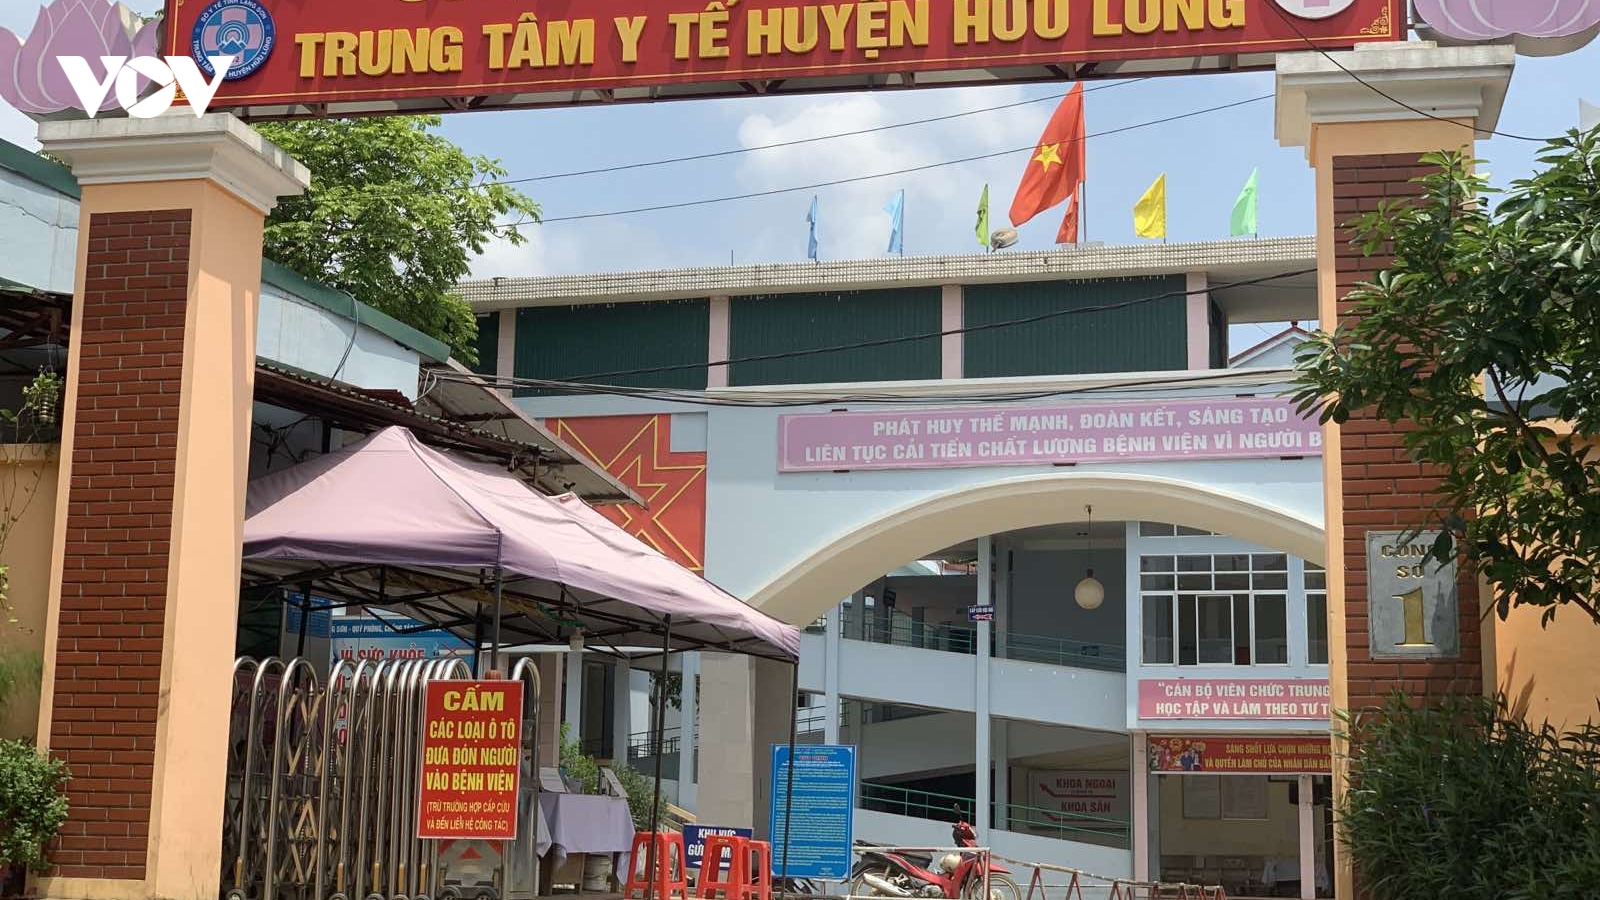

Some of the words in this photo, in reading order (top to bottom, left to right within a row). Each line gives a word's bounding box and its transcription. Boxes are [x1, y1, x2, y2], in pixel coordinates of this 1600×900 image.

[295, 26, 464, 77] TRUNG
[482, 12, 595, 69] TÂM
[614, 16, 647, 63] Y
[668, 0, 738, 59] TẾ
[873, 418, 920, 436] PHÁT
[927, 418, 963, 435] HUY
[1010, 413, 1074, 433] MẠNH,
[1080, 409, 1135, 429] ĐOÀN
[1140, 406, 1182, 428] KẾT,
[1189, 407, 1243, 426] SÁNG
[1250, 408, 1288, 426] TẠO
[805, 444, 847, 463] LIÊN
[852, 445, 887, 463] TỤC
[893, 438, 924, 459] CẢI
[930, 438, 972, 458] TIẾN
[978, 436, 1027, 457] CHẤT
[1033, 438, 1097, 458] LƯỢNG
[1103, 434, 1156, 456] BỆNH
[1162, 433, 1207, 454] VIỆN
[1214, 432, 1232, 450] VÌ
[1239, 428, 1302, 448] NGƯỜI
[1391, 586, 1435, 647] 1
[443, 684, 505, 712] CẤM
[1195, 683, 1213, 700] BỘ
[1216, 683, 1246, 697] VIÊN
[1249, 681, 1285, 698] CHỨC
[1156, 703, 1182, 717] HỌC
[1185, 702, 1209, 718] TẬP
[1213, 701, 1230, 715] VÀ
[1233, 701, 1263, 715] LÀM
[1265, 703, 1298, 715] THEO
[1301, 702, 1318, 715] TƯ
[430, 717, 453, 739] CÁC
[458, 721, 485, 743] LOẠI
[489, 718, 497, 740] Ô
[501, 718, 515, 740] TÔ
[426, 746, 449, 765] ĐƯA
[452, 744, 477, 765] ĐÓN
[480, 743, 516, 766] NGƯỜI
[426, 769, 449, 791] VÀO
[452, 769, 484, 795] BỆNH
[487, 769, 514, 795] VIỆN
[1056, 778, 1082, 789] KHOA
[1060, 801, 1087, 812] KHOA
